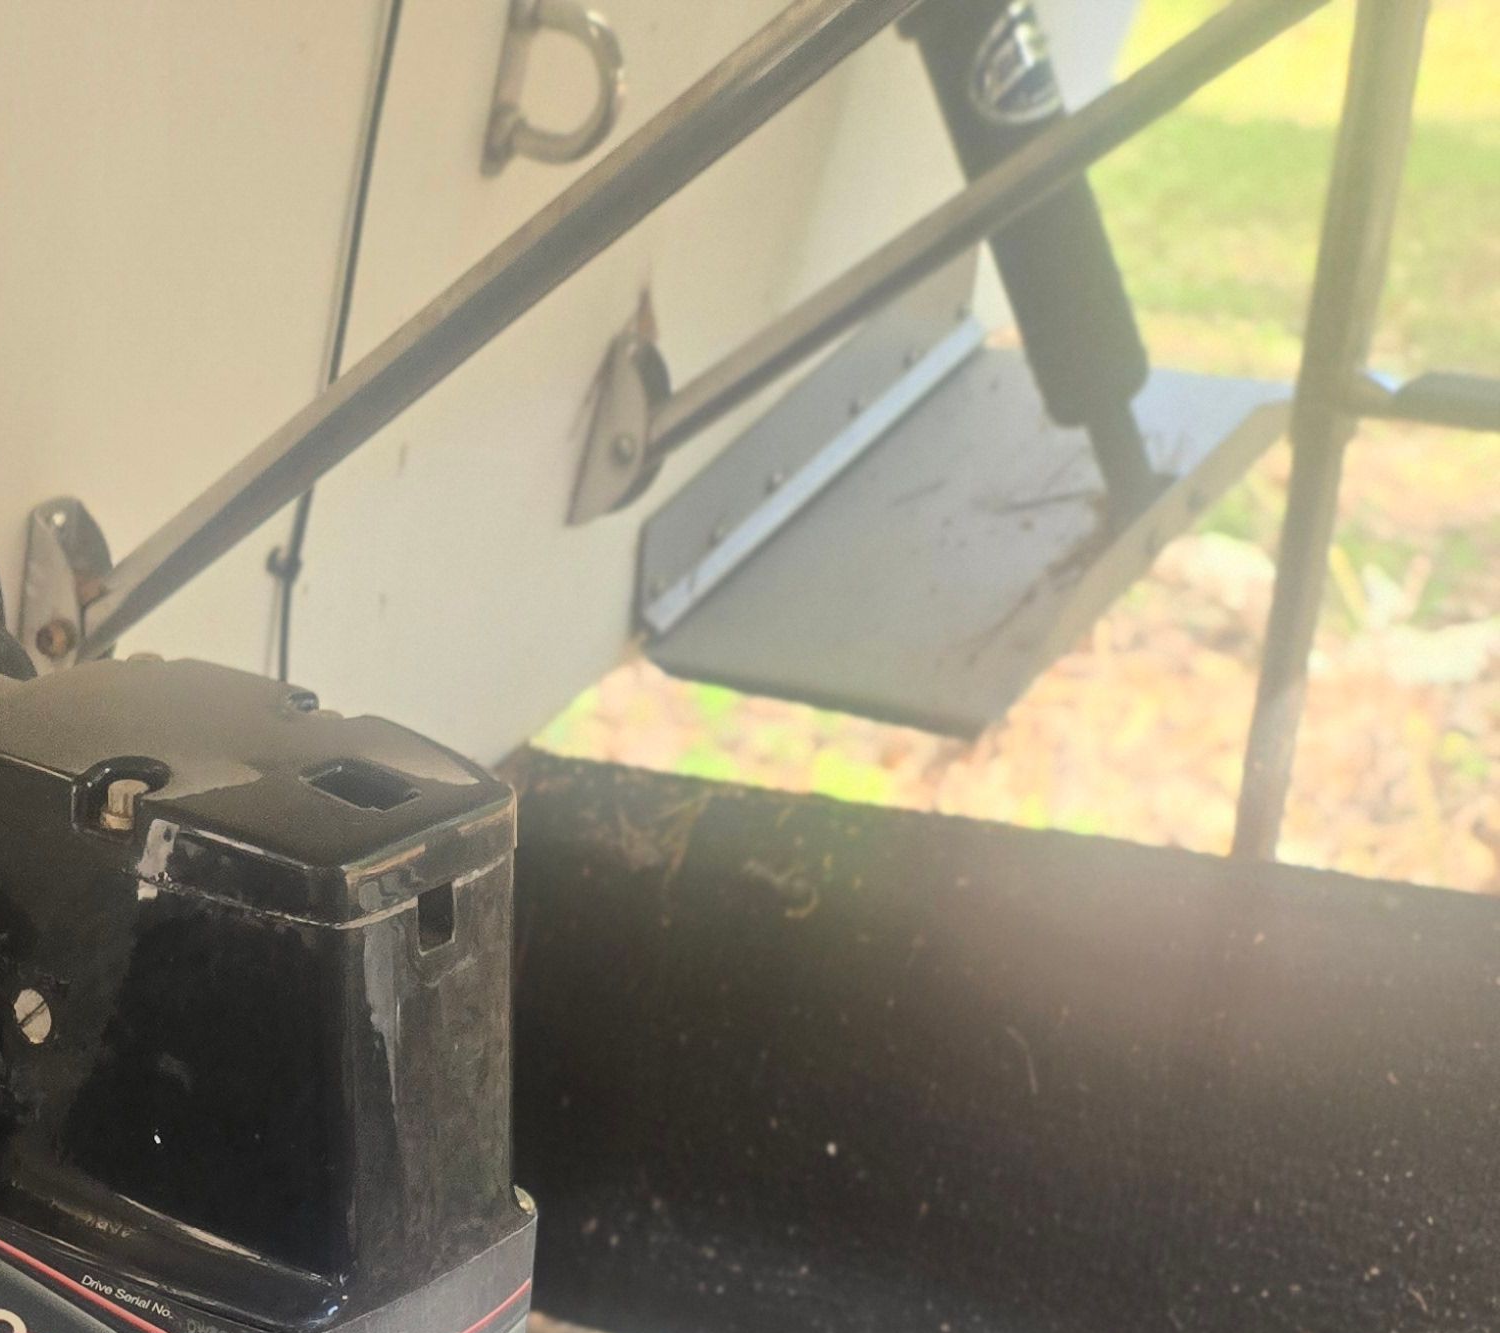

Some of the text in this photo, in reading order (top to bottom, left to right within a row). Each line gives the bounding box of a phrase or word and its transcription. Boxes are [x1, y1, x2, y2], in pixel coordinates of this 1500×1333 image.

[81, 1274, 113, 1296] Drive
[114, 1287, 152, 1310] Serial
[151, 1302, 174, 1320] No.
